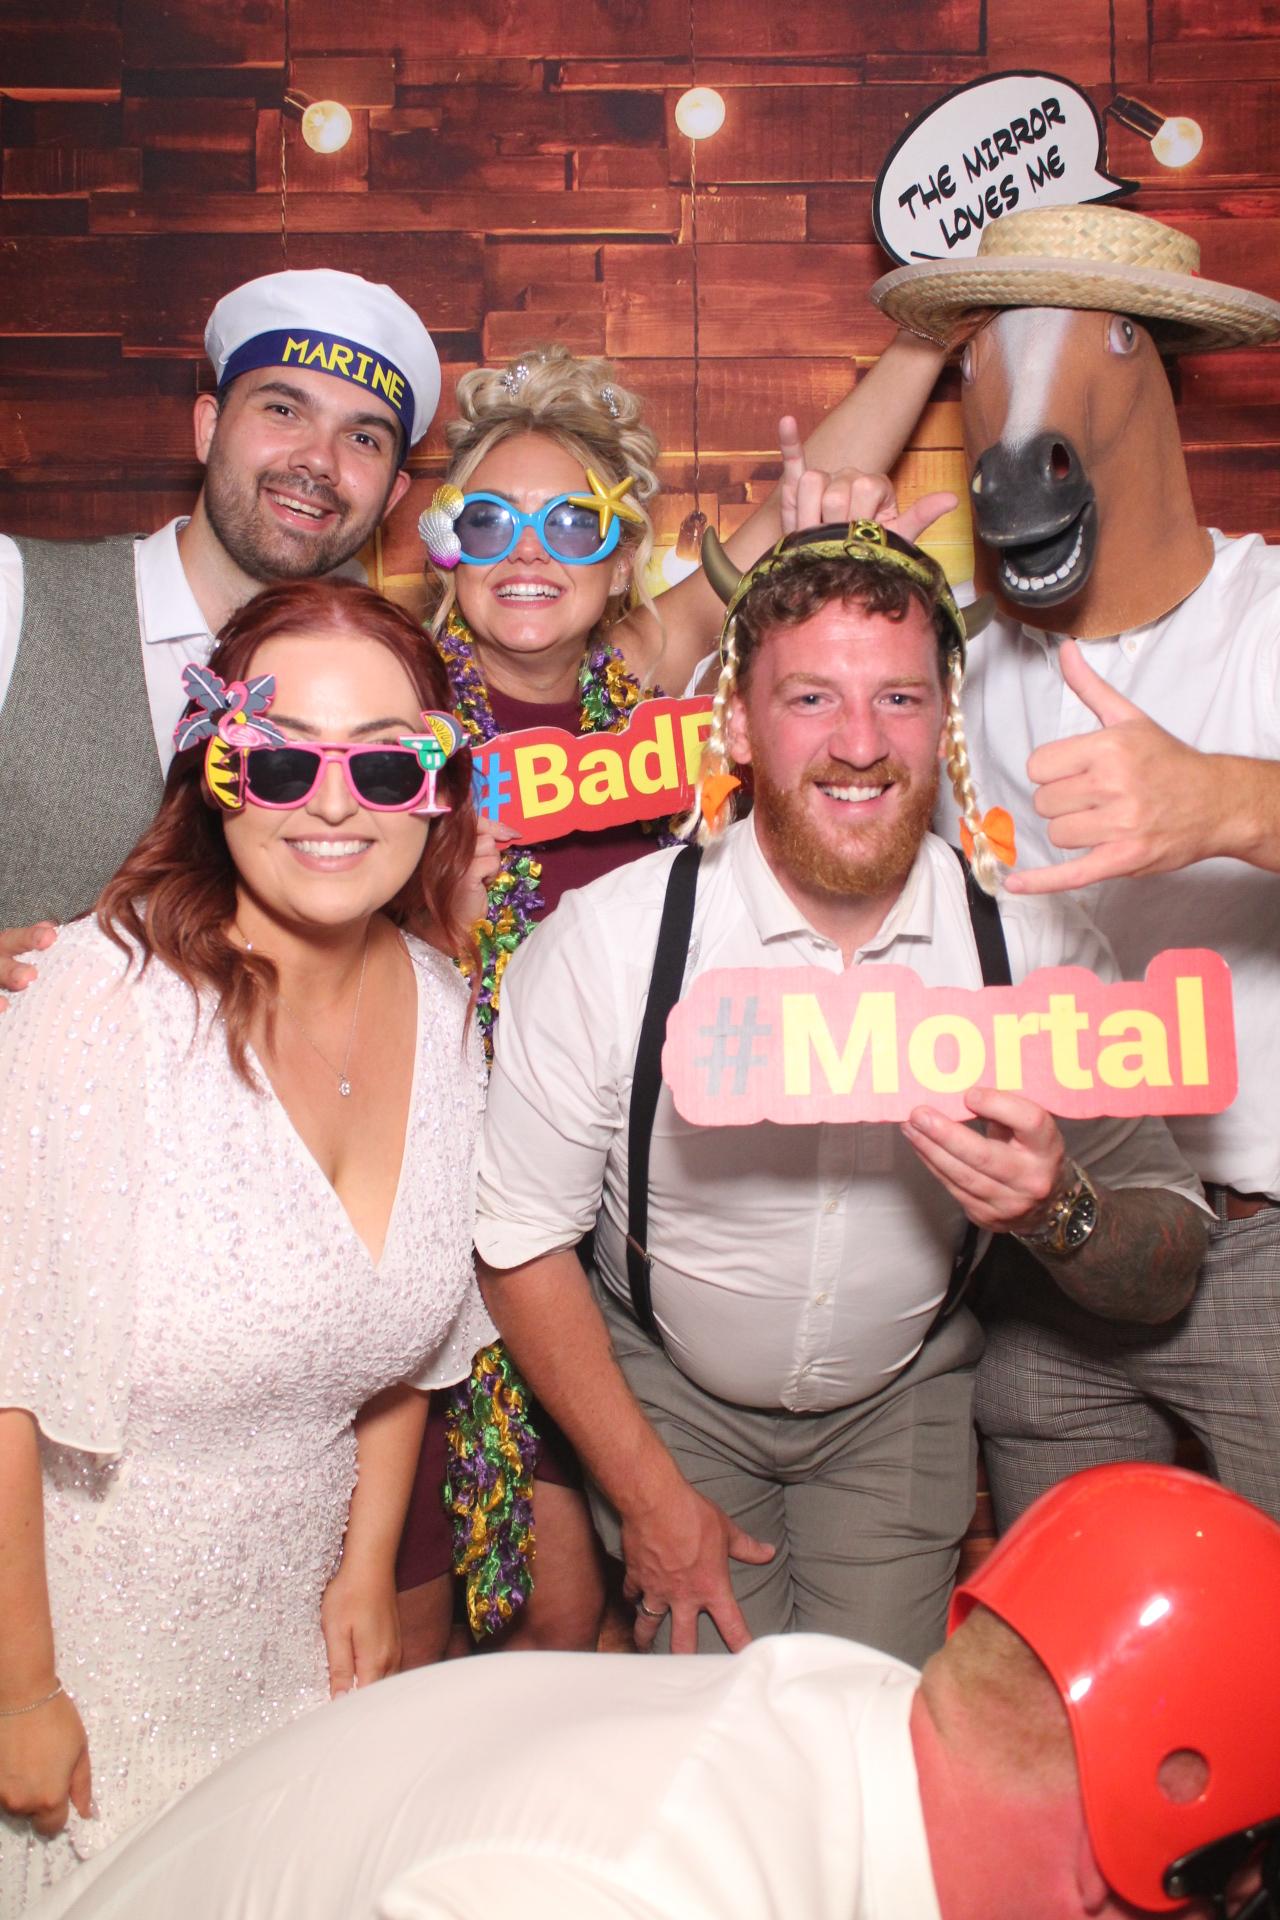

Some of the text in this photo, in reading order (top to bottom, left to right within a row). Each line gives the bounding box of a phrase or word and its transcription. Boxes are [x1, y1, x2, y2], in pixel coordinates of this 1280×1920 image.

[898, 97, 1066, 219] THE MIRROR
[939, 145, 1065, 249] LOVES ME
[281, 336, 405, 410] MARINE
[692, 976, 1210, 1097] #Mortal
